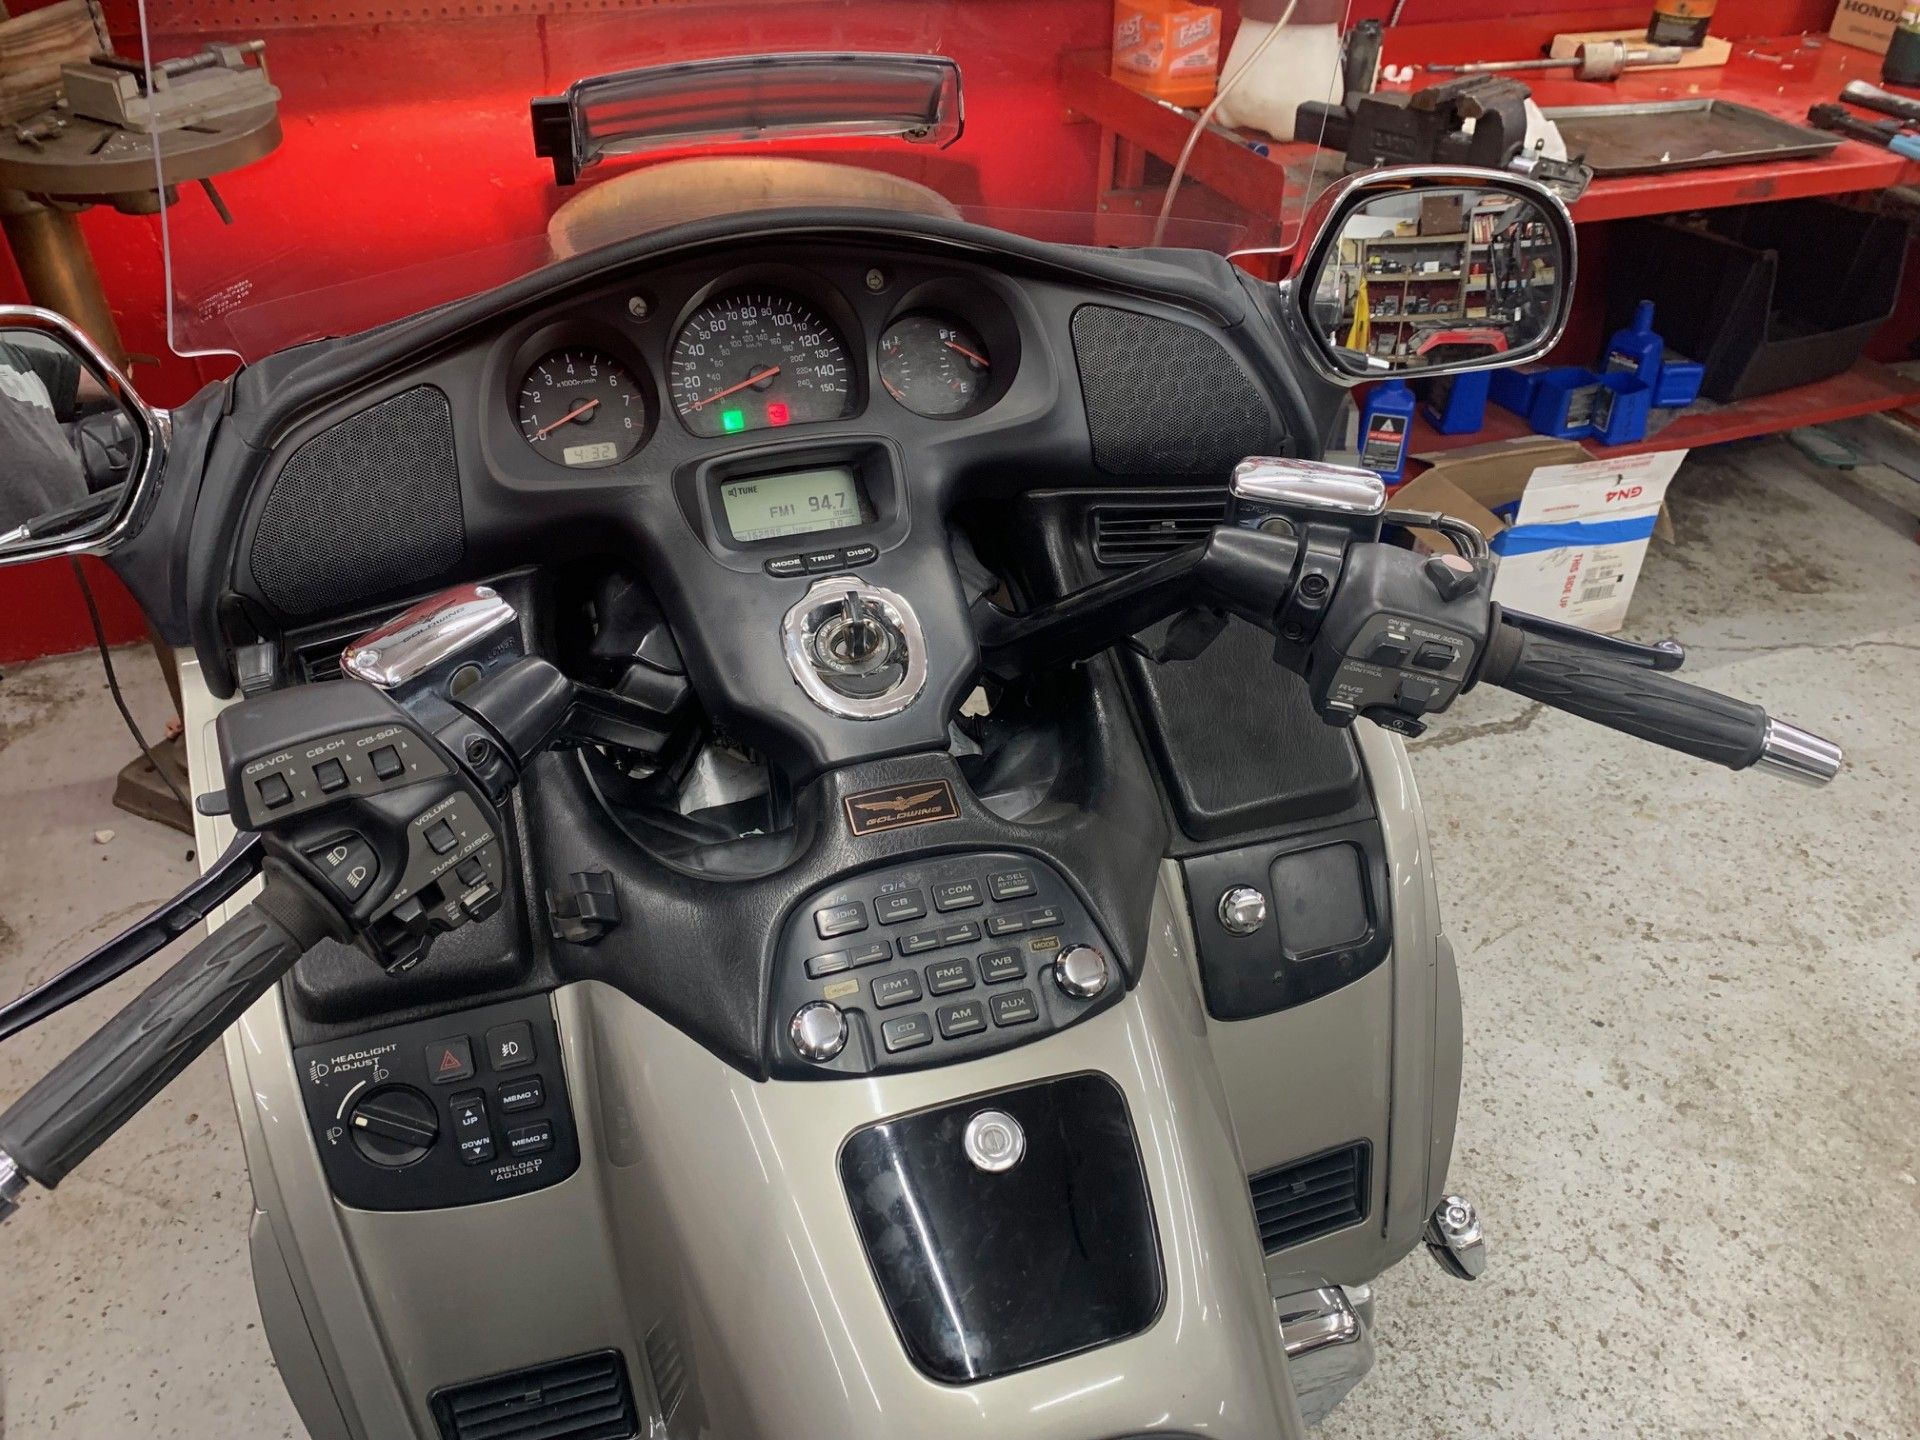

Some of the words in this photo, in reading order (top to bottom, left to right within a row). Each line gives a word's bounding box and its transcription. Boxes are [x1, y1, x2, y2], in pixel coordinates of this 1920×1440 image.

[726, 311, 738, 321] 70
[741, 306, 756, 318] 80
[761, 307, 772, 316] 90
[710, 320, 727, 332] 60
[772, 314, 792, 326] 100
[793, 322, 807, 332] 110
[700, 330, 711, 341] 50
[799, 333, 820, 347] 120
[949, 331, 957, 341] F
[688, 344, 705, 356] 40
[882, 340, 891, 350] H
[814, 348, 829, 359] 130
[566, 364, 574, 375] 4
[589, 365, 598, 376] 5
[684, 362, 696, 371] 30
[814, 364, 834, 377] 140
[545, 374, 553, 385] 3
[609, 375, 617, 387] 6
[684, 375, 701, 388] 20
[711, 373, 721, 381] 40
[820, 383, 834, 392] 150
[960, 382, 968, 393] E
[532, 391, 541, 403] 2
[622, 394, 630, 406] 7
[686, 392, 698, 401] 10
[531, 414, 538, 425] 1
[624, 417, 631, 428] 8
[574, 445, 610, 460] 4:32
[738, 485, 758, 496] TUNE
[1605, 485, 1643, 503] GN4
[769, 503, 796, 519] FM1
[808, 492, 846, 512] 94.7
[810, 553, 836, 563] TRIP
[846, 547, 873, 557] DISP
[771, 558, 801, 569] MODE
[1569, 553, 1583, 573] THIS
[1562, 574, 1577, 594] SIDE
[1559, 597, 1569, 608] UP
[1343, 665, 1383, 678] CONTROL
[1339, 683, 1364, 694] RVS
[356, 726, 403, 748] CB-SQL
[305, 738, 346, 759] CB-CH
[246, 752, 294, 775] CB-VOL
[414, 797, 457, 827] VOLUME
[866, 805, 943, 826] GOLDWING
[940, 883, 974, 897] I-COM
[890, 896, 909, 908] CB
[1043, 909, 1054, 918] 6
[995, 917, 1006, 926] 5
[959, 924, 970, 933] 4
[908, 935, 919, 944] 3
[870, 944, 880, 954] 2
[990, 956, 1013, 966] WB
[935, 965, 964, 979] FM2
[882, 978, 909, 991] FM1
[1000, 997, 1027, 1011] AUX
[951, 1007, 972, 1021] AM
[896, 1021, 916, 1033] CD
[330, 1044, 398, 1065] HEADLIGHT
[333, 1056, 381, 1074] ADJUST
[503, 1091, 532, 1104] MEMO
[533, 1089, 540, 1097] 1
[462, 1116, 479, 1126] UP
[461, 1137, 490, 1150] DOWN
[511, 1134, 540, 1147] MEMO
[541, 1133, 549, 1141] 2
[490, 1158, 543, 1176] PRELOAD
[495, 1165, 541, 1182] ADJUST
